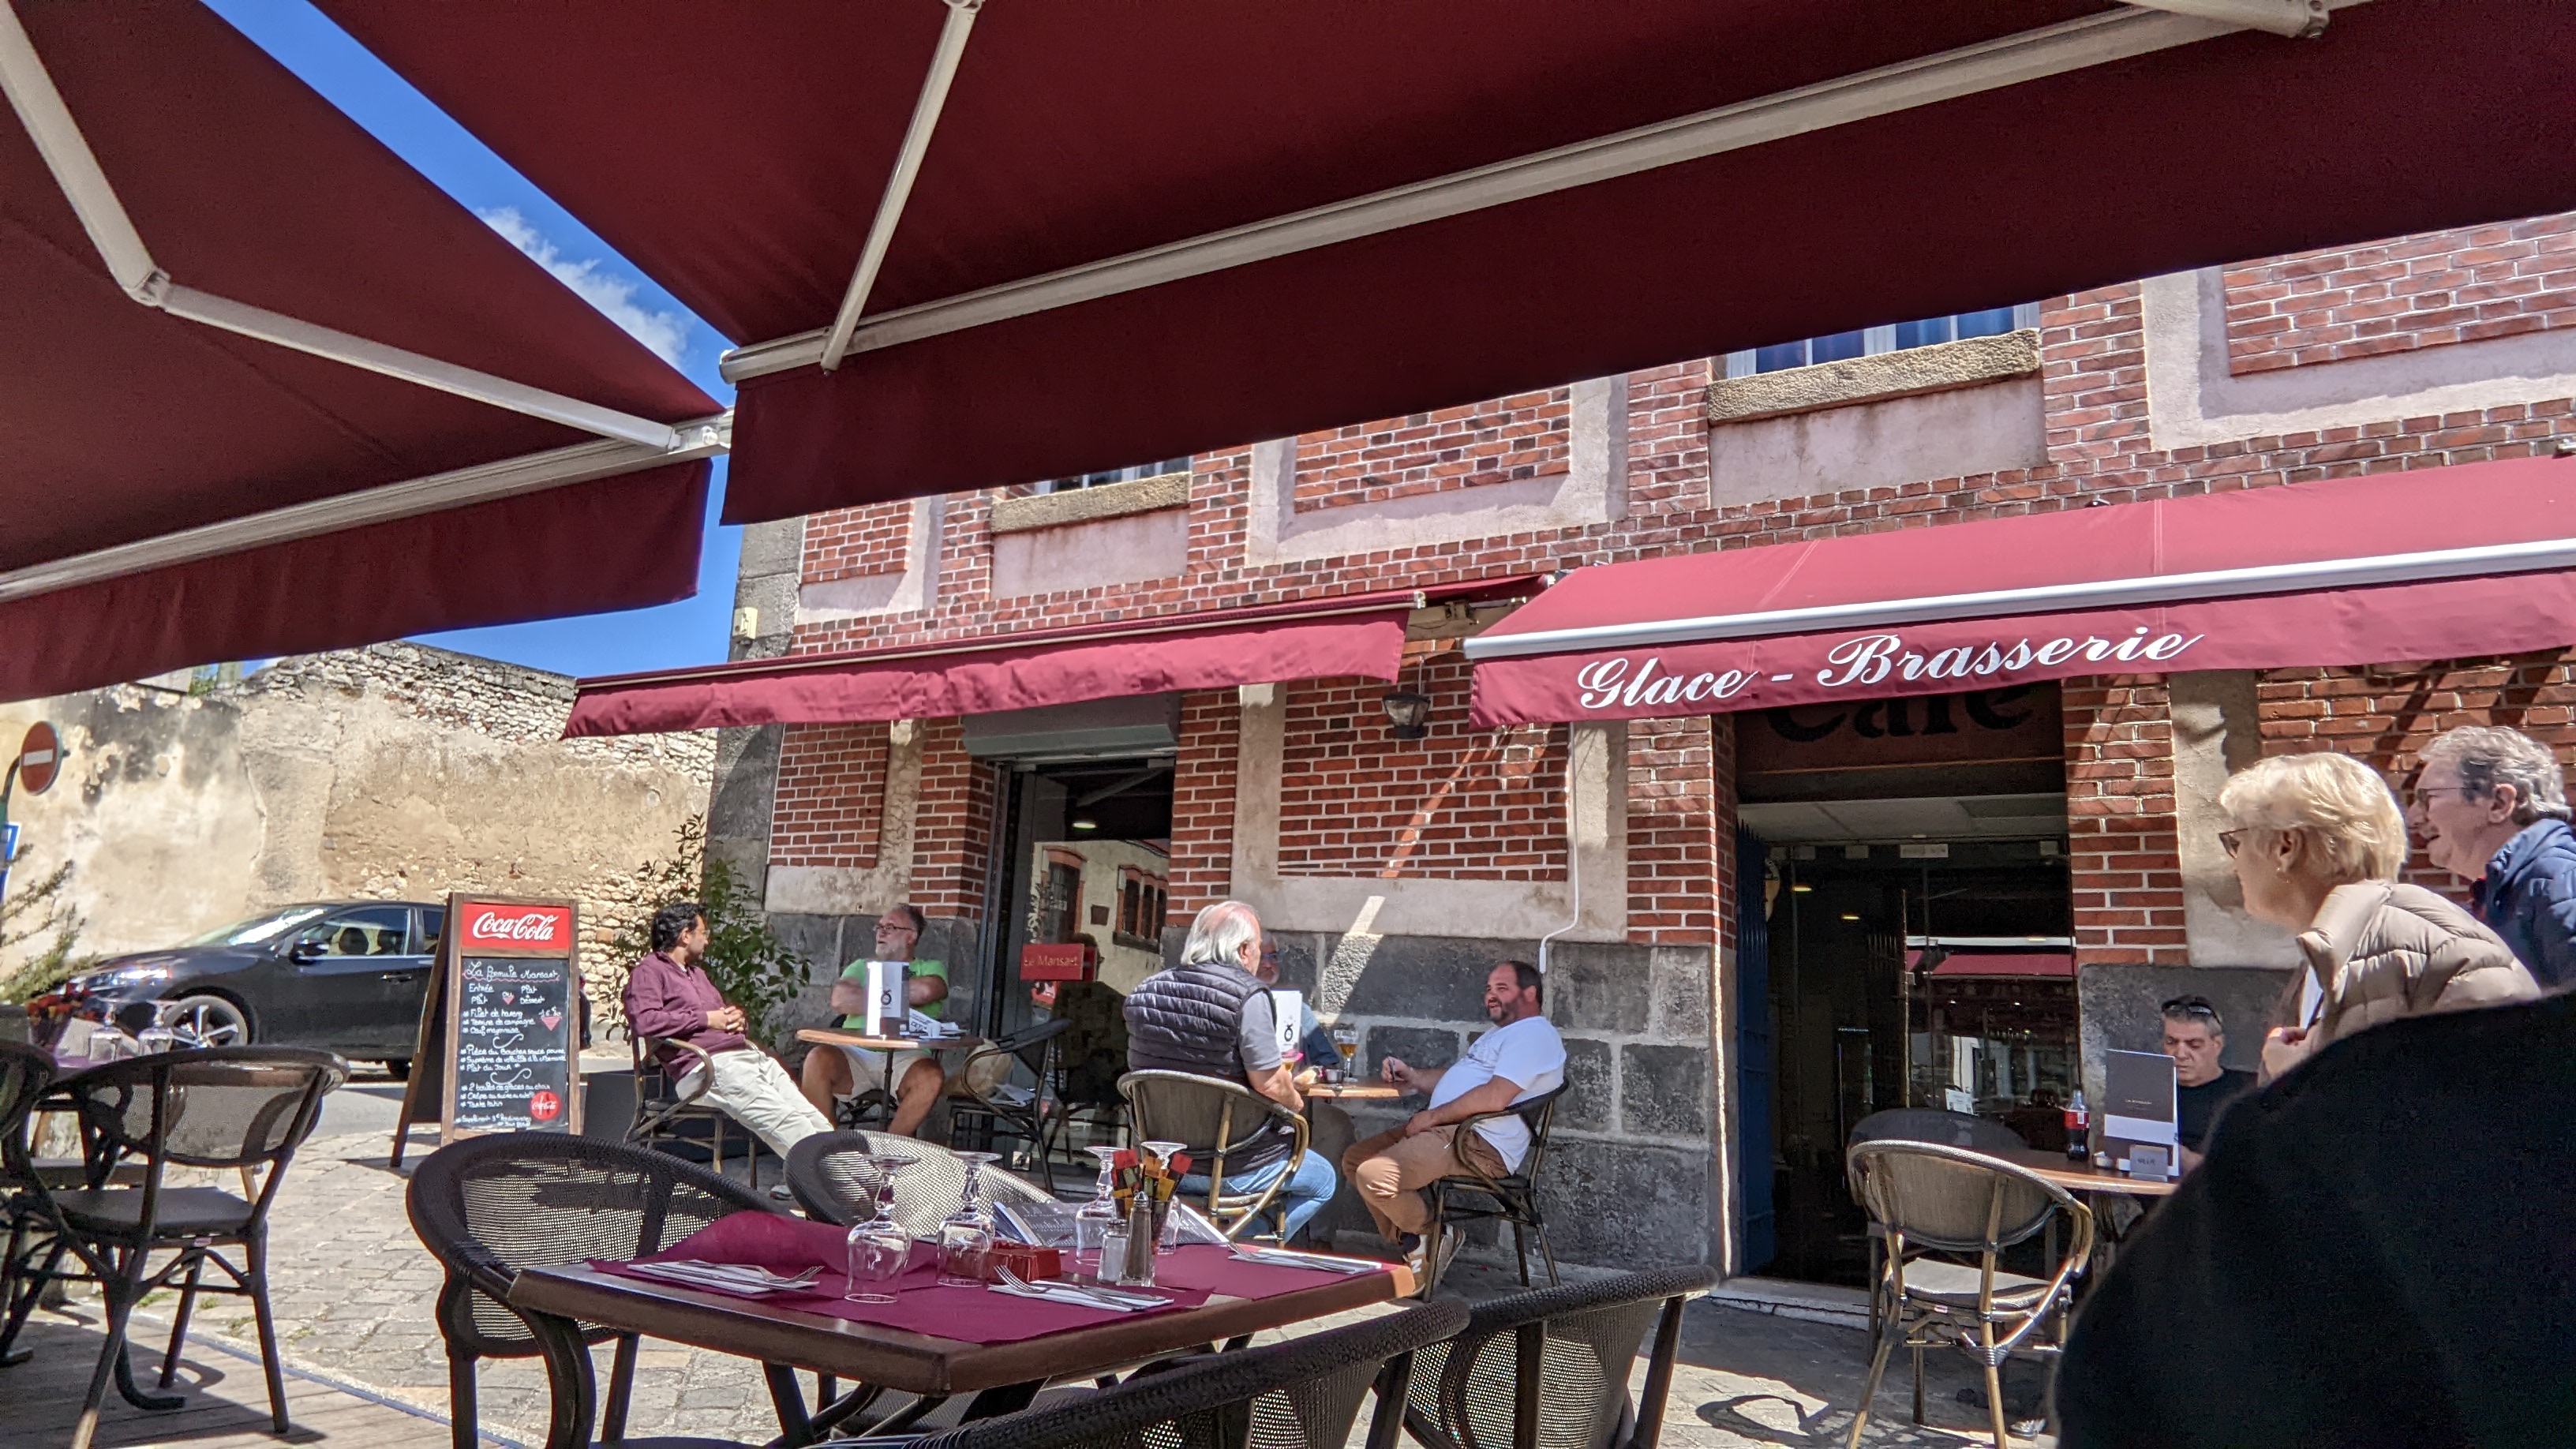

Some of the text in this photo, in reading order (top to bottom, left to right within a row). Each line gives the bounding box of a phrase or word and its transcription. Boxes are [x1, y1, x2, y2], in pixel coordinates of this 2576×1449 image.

[1578, 657, 1759, 709] Glace
[1816, 627, 2206, 687] Brasserie
[473, 912, 559, 940] Coca-Cola
[1038, 954, 1079, 966] Mansart
[466, 961, 557, 982] La formule Mansart
[469, 983, 494, 993] Entrée
[521, 985, 537, 994] Plat
[470, 1006, 489, 1017] Filet
[490, 1009, 500, 1017] de
[466, 1064, 481, 1073] Plat
[469, 1082, 475, 1091] 2
[476, 1081, 496, 1091] boules
